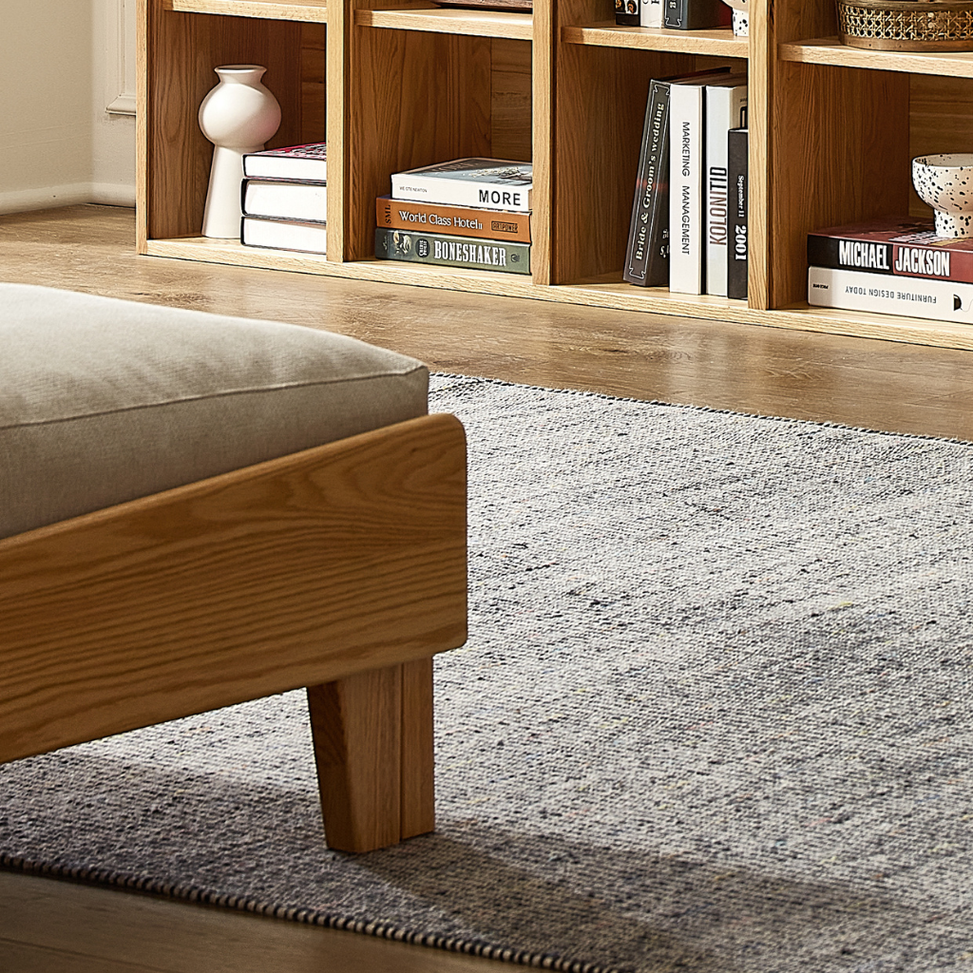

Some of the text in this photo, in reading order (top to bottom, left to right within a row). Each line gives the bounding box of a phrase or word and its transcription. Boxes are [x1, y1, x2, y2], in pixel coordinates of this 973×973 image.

[478, 189, 521, 206] MORE
[635, 102, 665, 261] Bride & Groom's wedding
[681, 121, 691, 256] MARKETING MANAGEMENT
[737, 175, 745, 209] September
[384, 205, 392, 224] SML
[398, 210, 427, 224] World
[428, 214, 452, 226] Class
[453, 216, 478, 229] Hotel
[709, 166, 727, 246] KOLONITID
[433, 240, 507, 267] BONESHAKER
[735, 225, 747, 261] 2001
[838, 239, 951, 277] MICHAEL JACKSON
[844, 285, 937, 304] FURNITURE DESIGN TODAY
